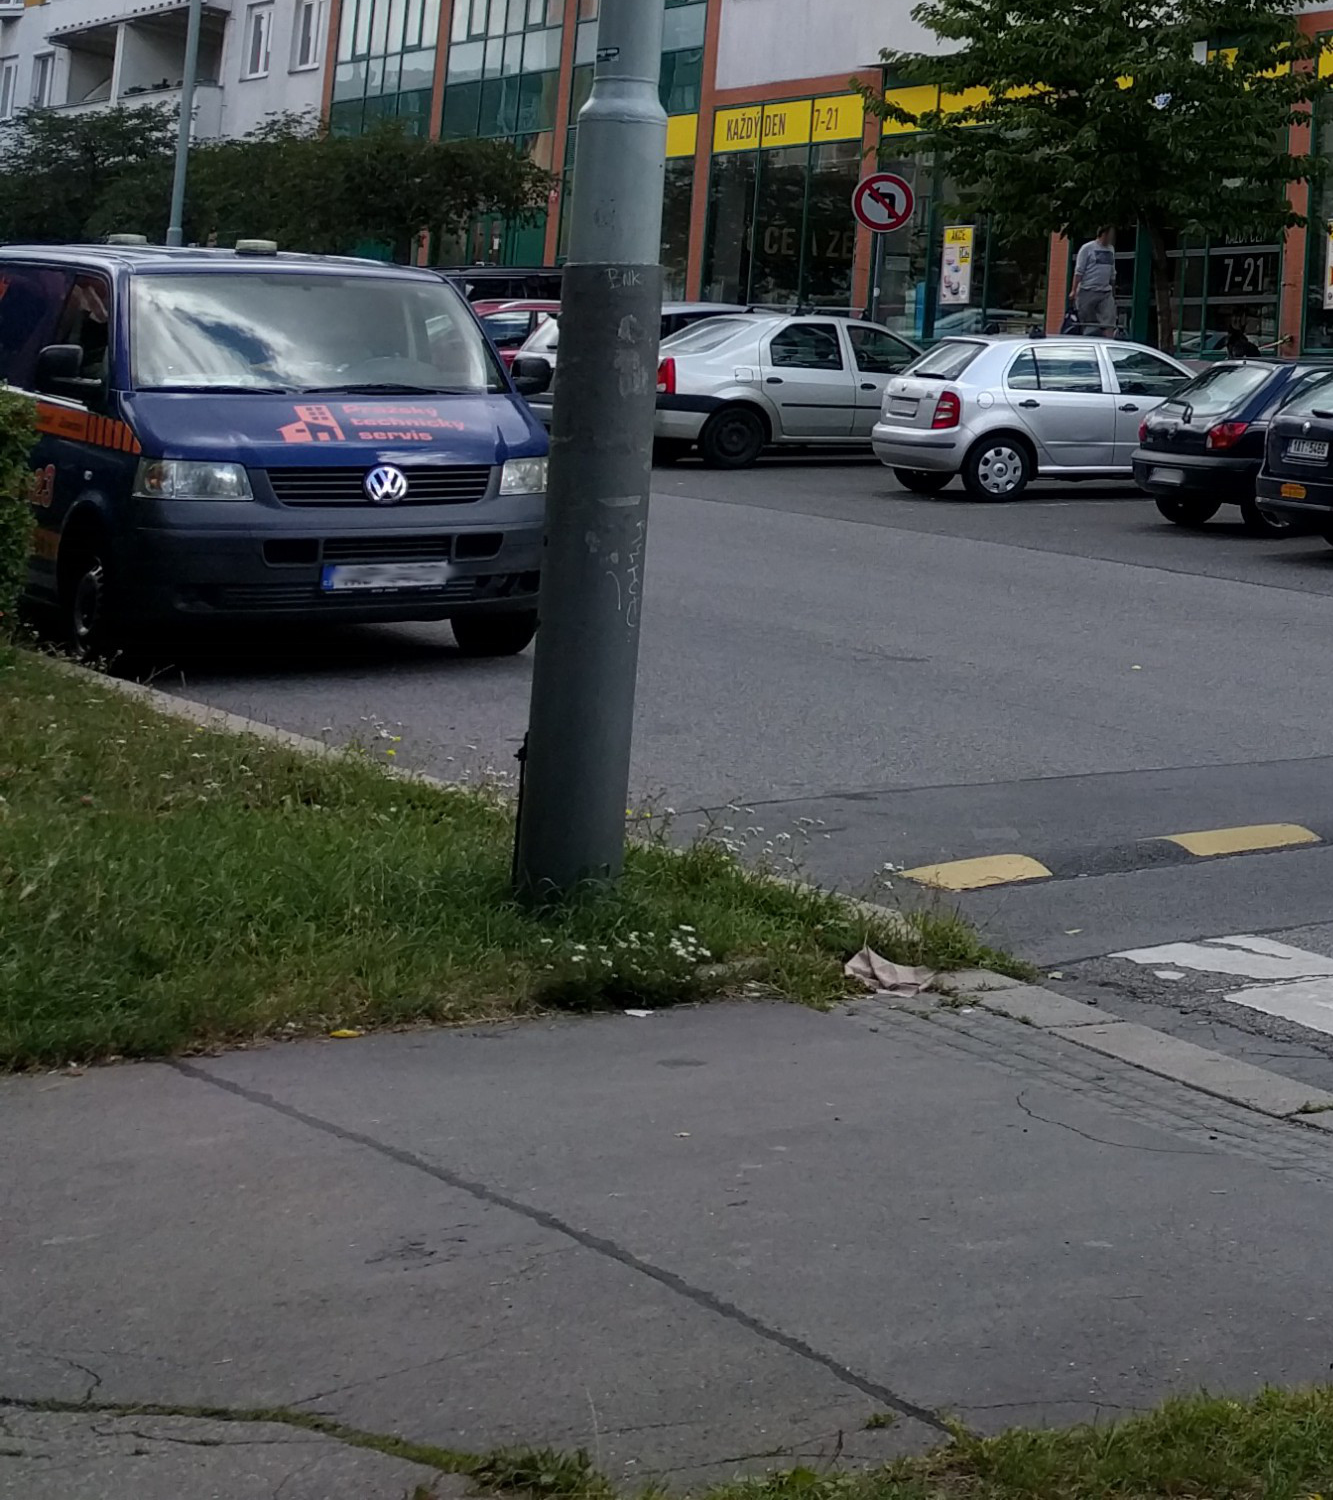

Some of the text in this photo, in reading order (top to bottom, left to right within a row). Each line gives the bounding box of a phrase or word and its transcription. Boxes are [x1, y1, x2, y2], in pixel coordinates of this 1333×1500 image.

[726, 107, 840, 141] KAŽDÝ DEN 7-21
[1224, 257, 1264, 292] 7-21
[357, 429, 433, 441] servis
